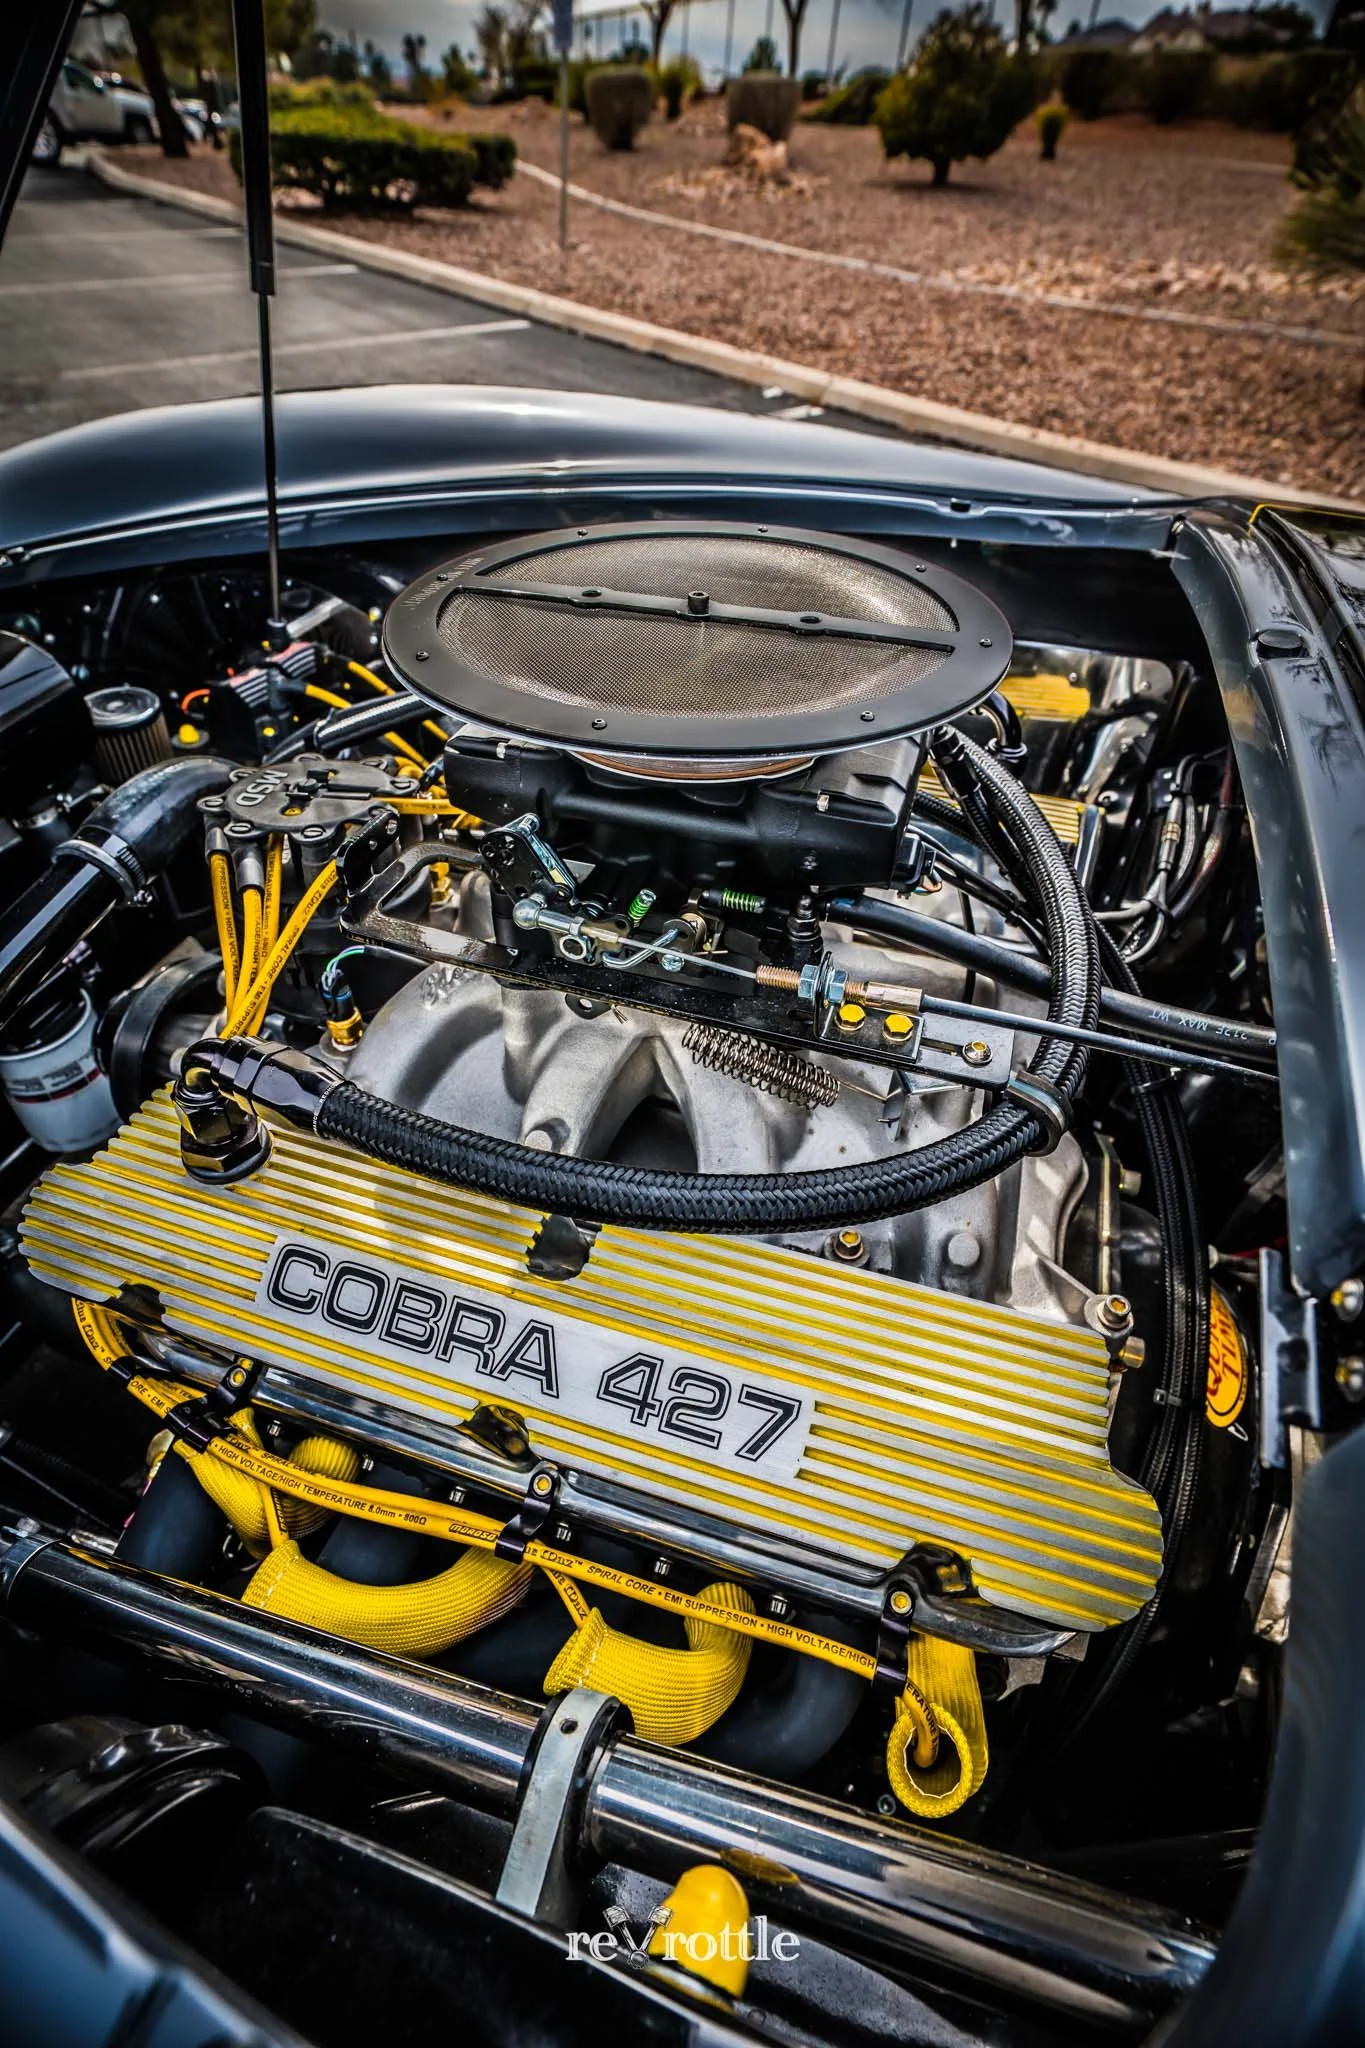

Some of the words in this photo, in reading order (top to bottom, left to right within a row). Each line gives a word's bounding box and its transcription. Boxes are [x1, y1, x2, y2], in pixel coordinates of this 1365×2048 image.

[236, 770, 289, 806] MSD
[225, 917, 237, 943] HIGH
[280, 925, 299, 957] SPIRAL
[267, 955, 285, 981] CORE
[253, 984, 267, 1003] EMI
[1179, 1017, 1209, 1031] MAX
[266, 1243, 559, 1398] COBRA
[596, 1352, 802, 1462] 427
[131, 1379, 149, 1396] ORE
[151, 1396, 166, 1410] EMI
[218, 1446, 240, 1461] HIGH
[240, 1457, 301, 1490] VOLTAGE/HIGH
[303, 1484, 367, 1511] TEMPERATURE
[449, 1523, 498, 1542] MOROSO
[587, 1565, 623, 1585] SPIRAL
[625, 1579, 656, 1595] CORE
[664, 1592, 683, 1605] EMI
[685, 1599, 758, 1628] SUPPRESSION
[767, 1623, 793, 1639] HIGH
[796, 1631, 876, 1671] VOLTAGE/HIGH
[906, 1682, 937, 1737] ERATURE
